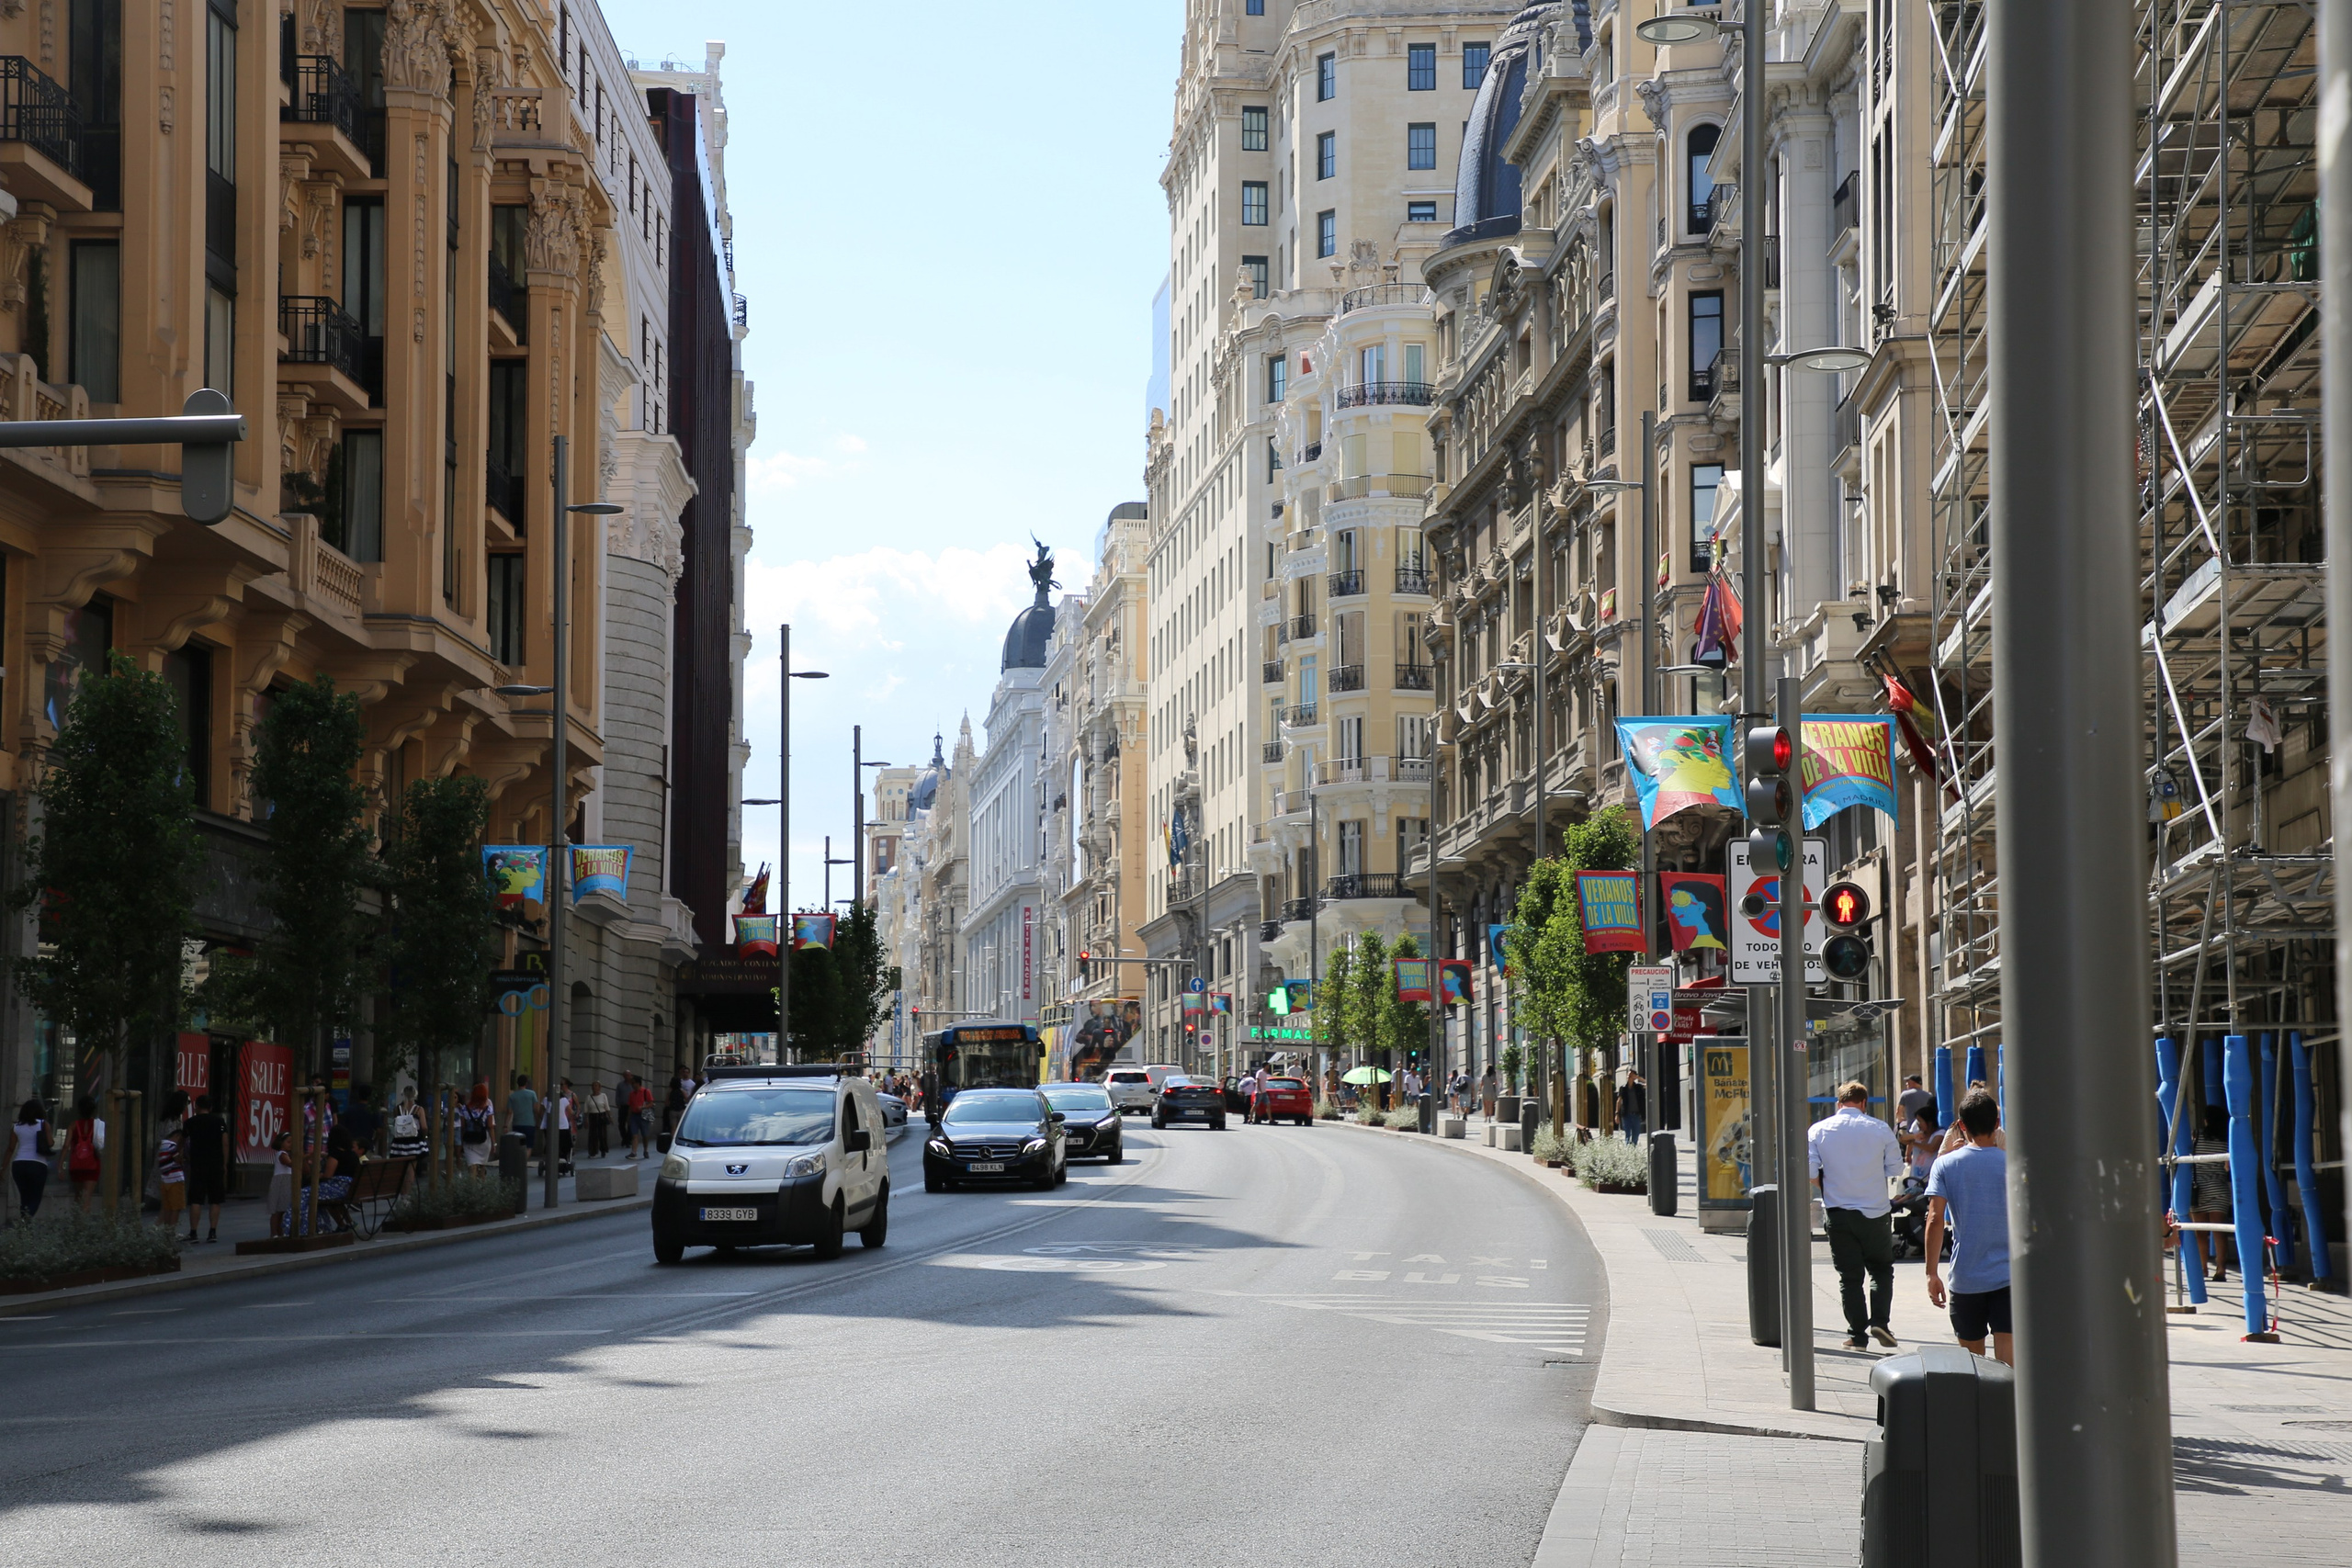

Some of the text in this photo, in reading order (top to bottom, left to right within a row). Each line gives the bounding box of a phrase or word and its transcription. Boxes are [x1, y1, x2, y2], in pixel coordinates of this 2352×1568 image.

[1802, 749, 1892, 788] DE LA VILLA
[1843, 794, 1885, 807] MADRID
[575, 861, 623, 882] DE LA VILLA
[1583, 879, 1634, 904] VERANOS
[1586, 904, 1637, 927] DE LA VILLA
[1747, 943, 1779, 952] TODO
[1631, 967, 1669, 976] PRECAUCIÓN
[1735, 961, 1749, 970] DE
[700, 974, 767, 982] ADMINISTRATIVO
[707, 1209, 754, 1220] 8339 GYB
[1331, 1269, 1530, 1288] BUS
